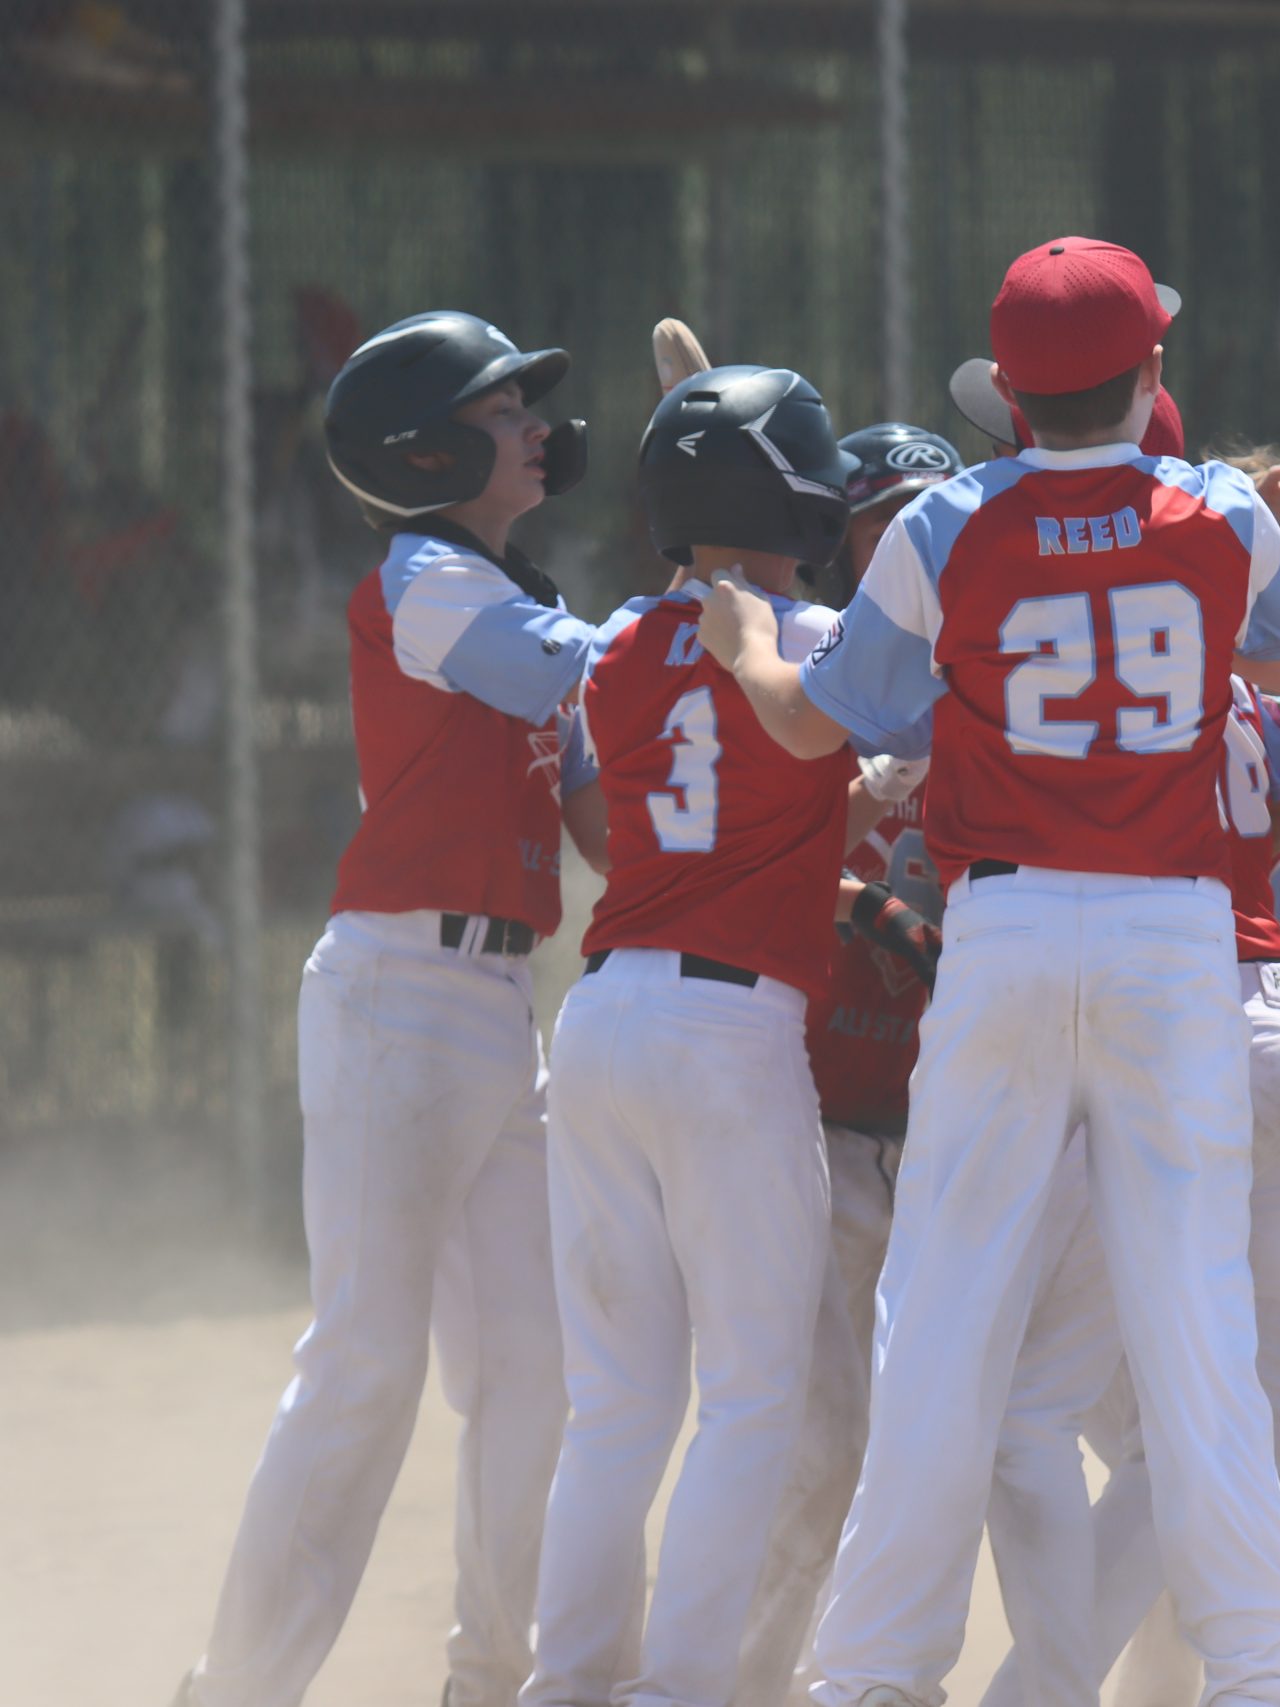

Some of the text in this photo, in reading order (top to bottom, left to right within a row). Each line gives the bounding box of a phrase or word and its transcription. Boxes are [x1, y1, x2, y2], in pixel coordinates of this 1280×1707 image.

[1035, 506, 1142, 556] REED
[1000, 580, 1206, 760] 29
[647, 684, 723, 853] 3
